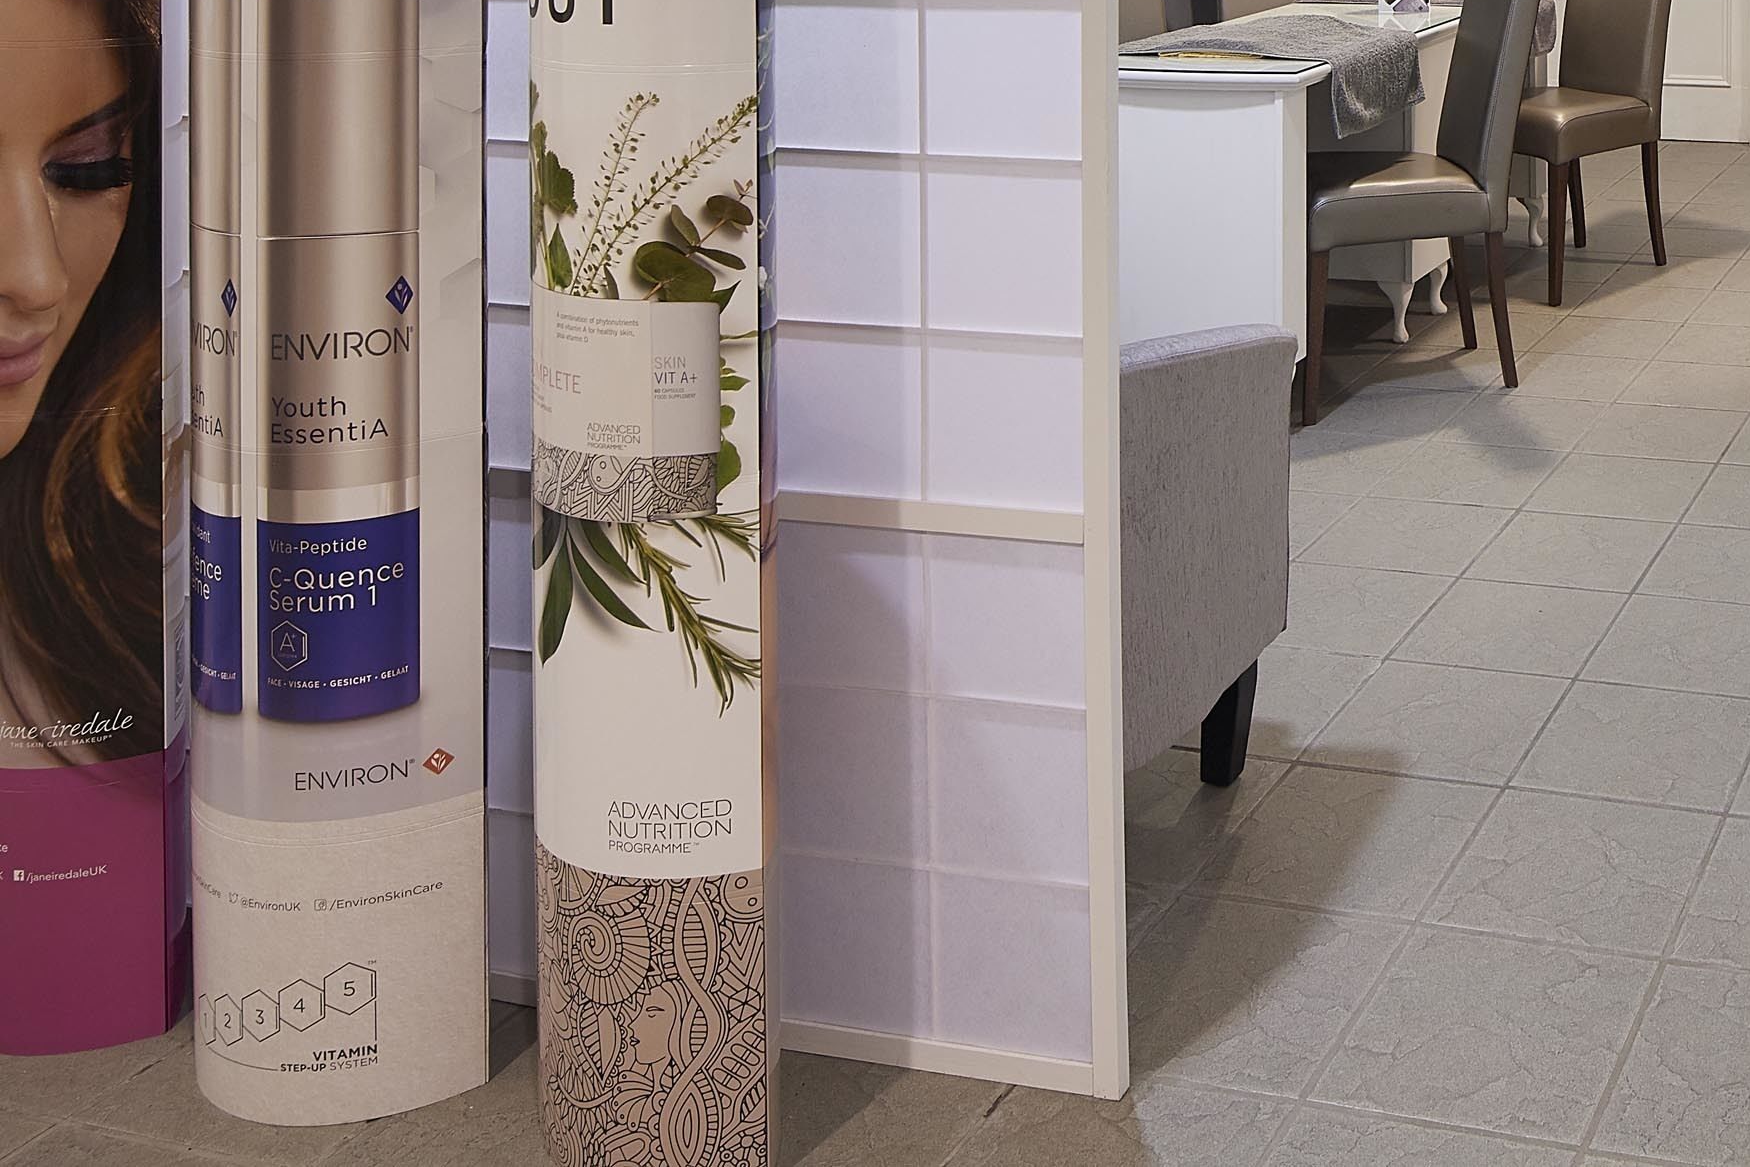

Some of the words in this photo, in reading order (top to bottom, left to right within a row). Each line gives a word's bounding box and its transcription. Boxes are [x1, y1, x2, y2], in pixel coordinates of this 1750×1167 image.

[596, 318, 639, 327] phytonutrients
[597, 328, 618, 337] healthy
[654, 356, 686, 369] SKIN
[654, 372, 677, 384] VIT
[680, 371, 698, 384] A+
[272, 396, 347, 418] Youth
[271, 418, 389, 444] EssentiA
[587, 422, 641, 435] ADVANCED
[587, 432, 641, 445] NUTRITION
[269, 537, 368, 556] Vita-Peptide
[269, 562, 404, 590] C-Quence
[269, 589, 355, 613] Serum
[367, 585, 376, 606] 1
[267, 676, 282, 687] FACE
[288, 680, 320, 689] VISAGE
[329, 674, 372, 688] GESICHT
[380, 665, 409, 680] GELAAT
[40, 707, 134, 738] iredale
[11, 741, 23, 749] THE
[47, 740, 68, 748] CARE
[608, 799, 732, 820] ADVANCED
[608, 818, 732, 839] NUTRITION
[26, 864, 107, 884] /janeiredaleUK
[240, 898, 300, 912] @EnvironUK
[329, 880, 443, 911] /EnvironSkinCare
[343, 980, 356, 997] 5
[293, 998, 305, 1013] 4
[224, 1012, 232, 1029] 2
[255, 1009, 264, 1024] 3
[313, 1044, 378, 1061] VITAMIN
[280, 1063, 326, 1072] STEP-UP
[329, 1056, 378, 1071] SYSTEM
